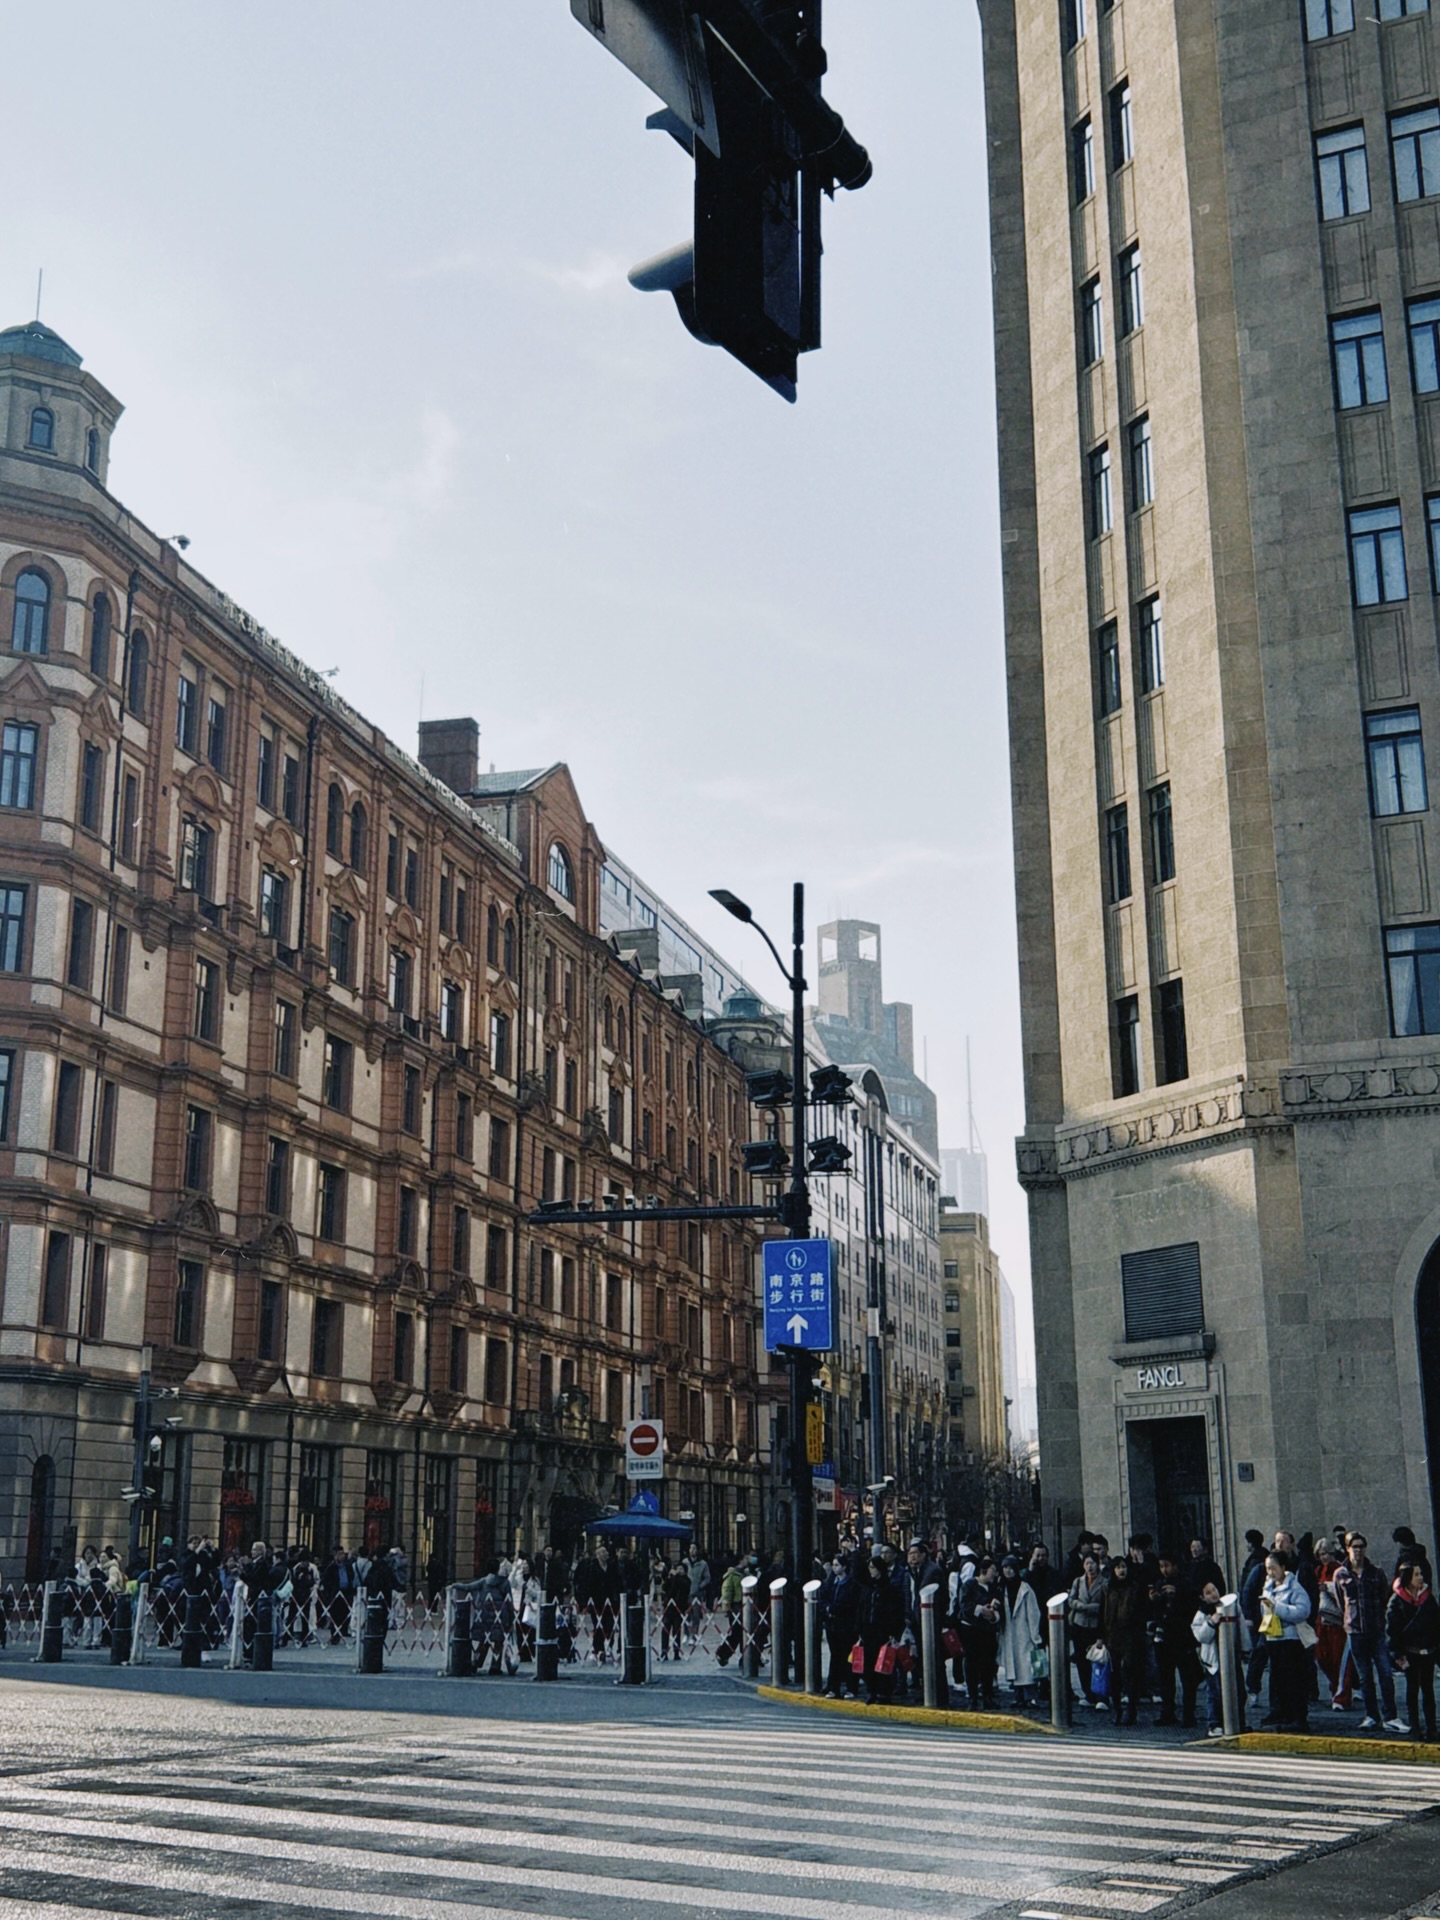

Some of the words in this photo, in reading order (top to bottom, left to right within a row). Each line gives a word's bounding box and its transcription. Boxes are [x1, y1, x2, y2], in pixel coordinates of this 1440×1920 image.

[419, 765, 455, 804] SWATCH
[472, 810, 498, 841] PEACE
[497, 833, 523, 862] HOTEL
[769, 1272, 824, 1288] 南京路
[769, 1289, 824, 1304] 步行街
[1137, 1365, 1184, 1390] FANCL
